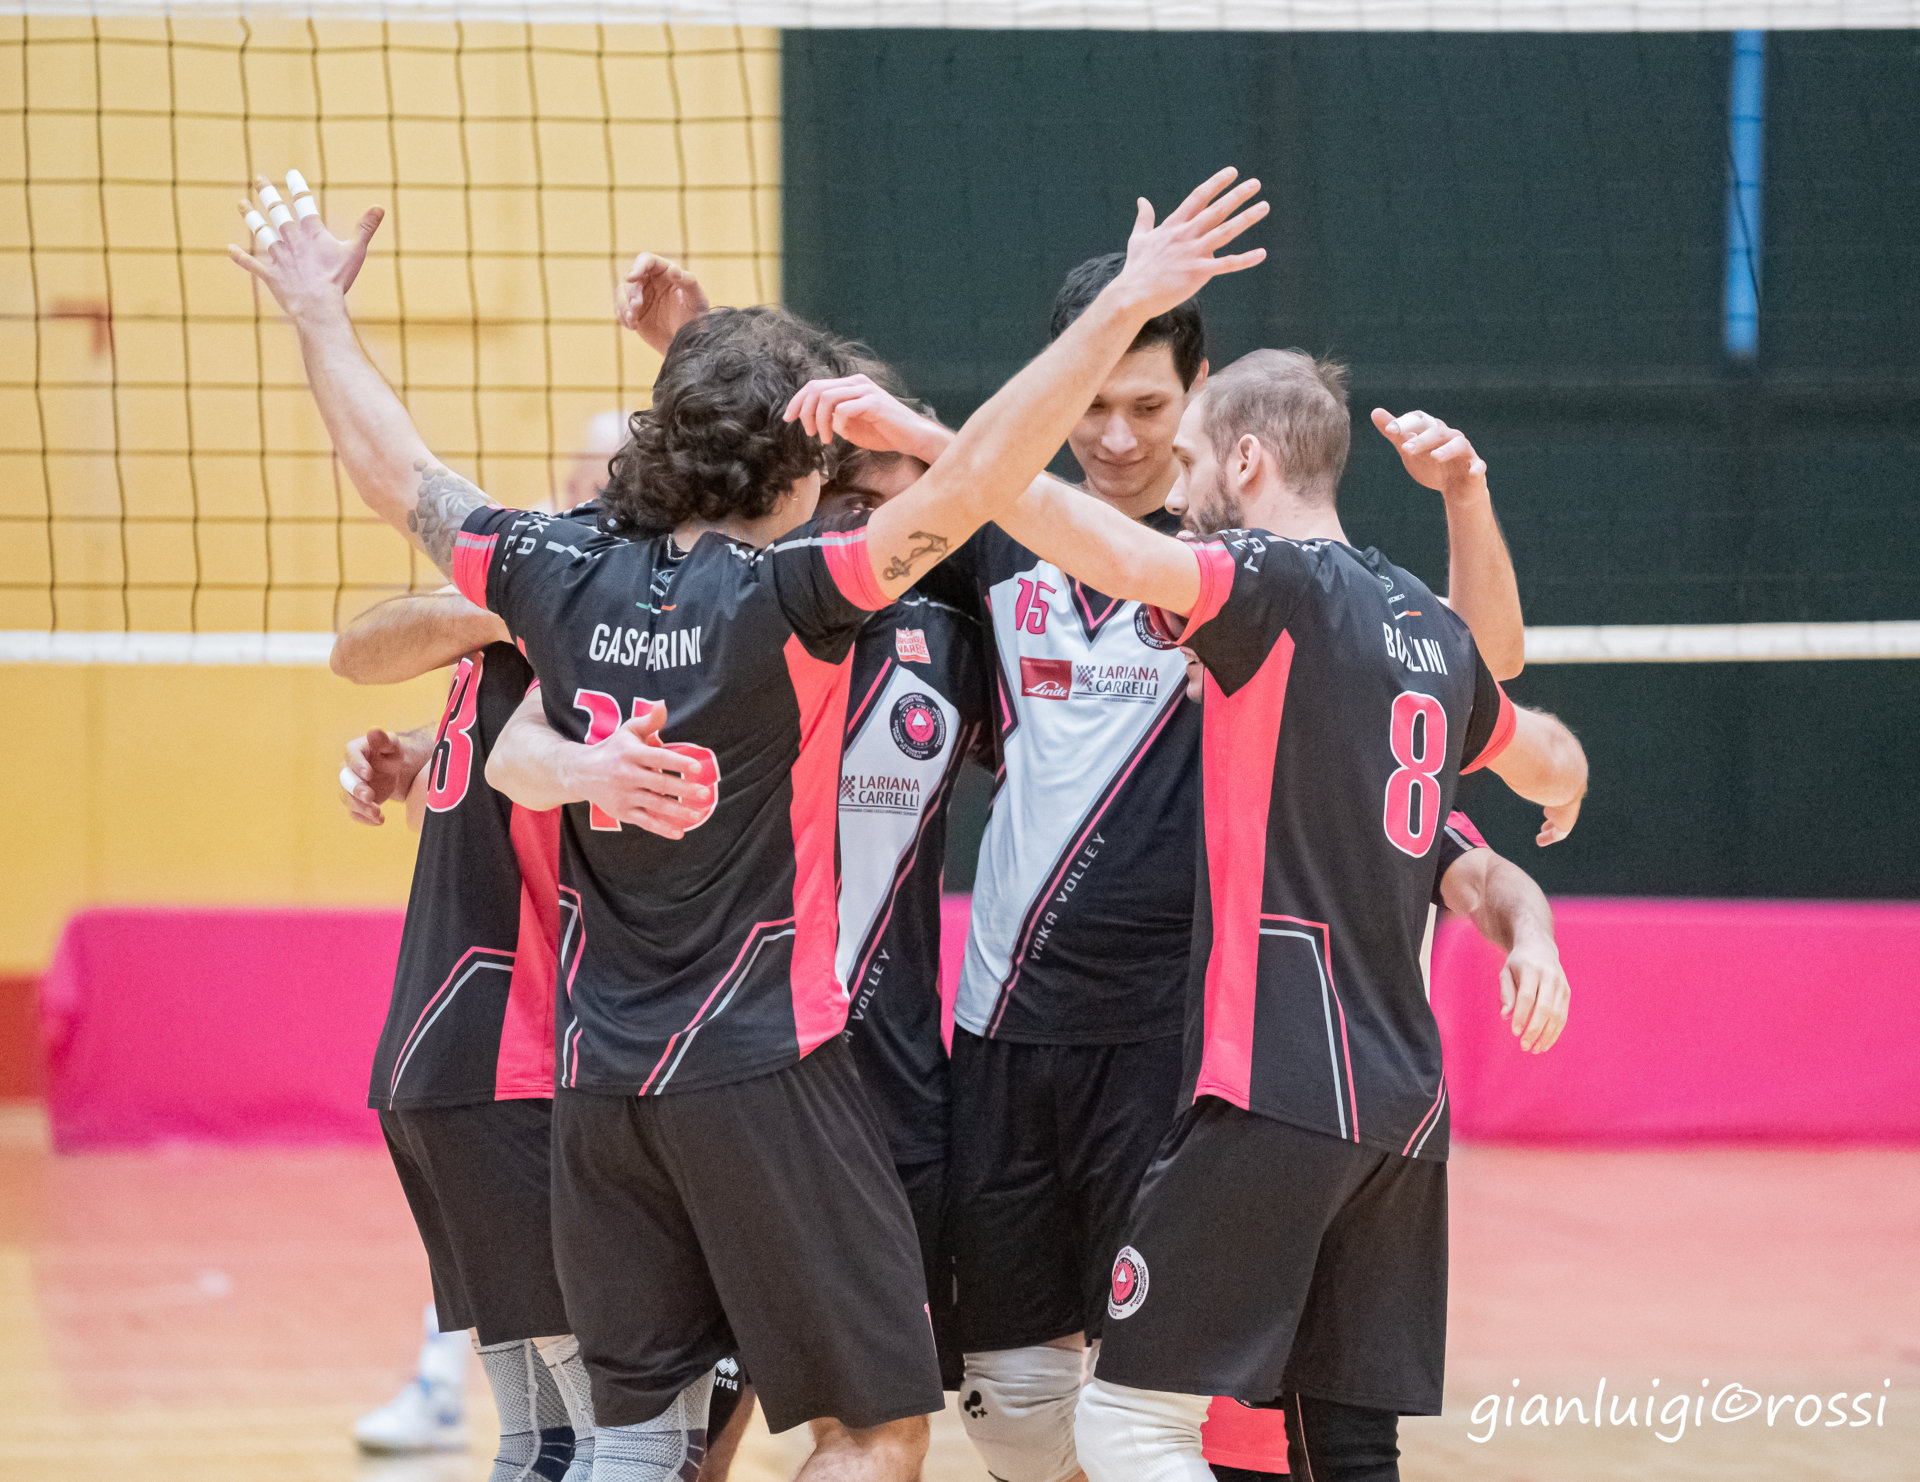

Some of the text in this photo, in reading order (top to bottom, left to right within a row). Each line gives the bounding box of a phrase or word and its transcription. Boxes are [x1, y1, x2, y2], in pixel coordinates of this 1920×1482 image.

[1015, 576, 1057, 635] 15
[588, 623, 702, 672] GASPARINI
[1098, 665, 1159, 682] LARIANA
[1024, 680, 1068, 697] Linde
[1096, 680, 1159, 697] CARRELLI
[859, 775, 920, 792] LARIANA
[1383, 690, 1448, 859] 8
[858, 790, 920, 808] CARRELLI
[1030, 832, 1106, 960] YAKA VOLLEY
[851, 948, 890, 1021] VOLLEY
[715, 1376, 738, 1391] rrea
